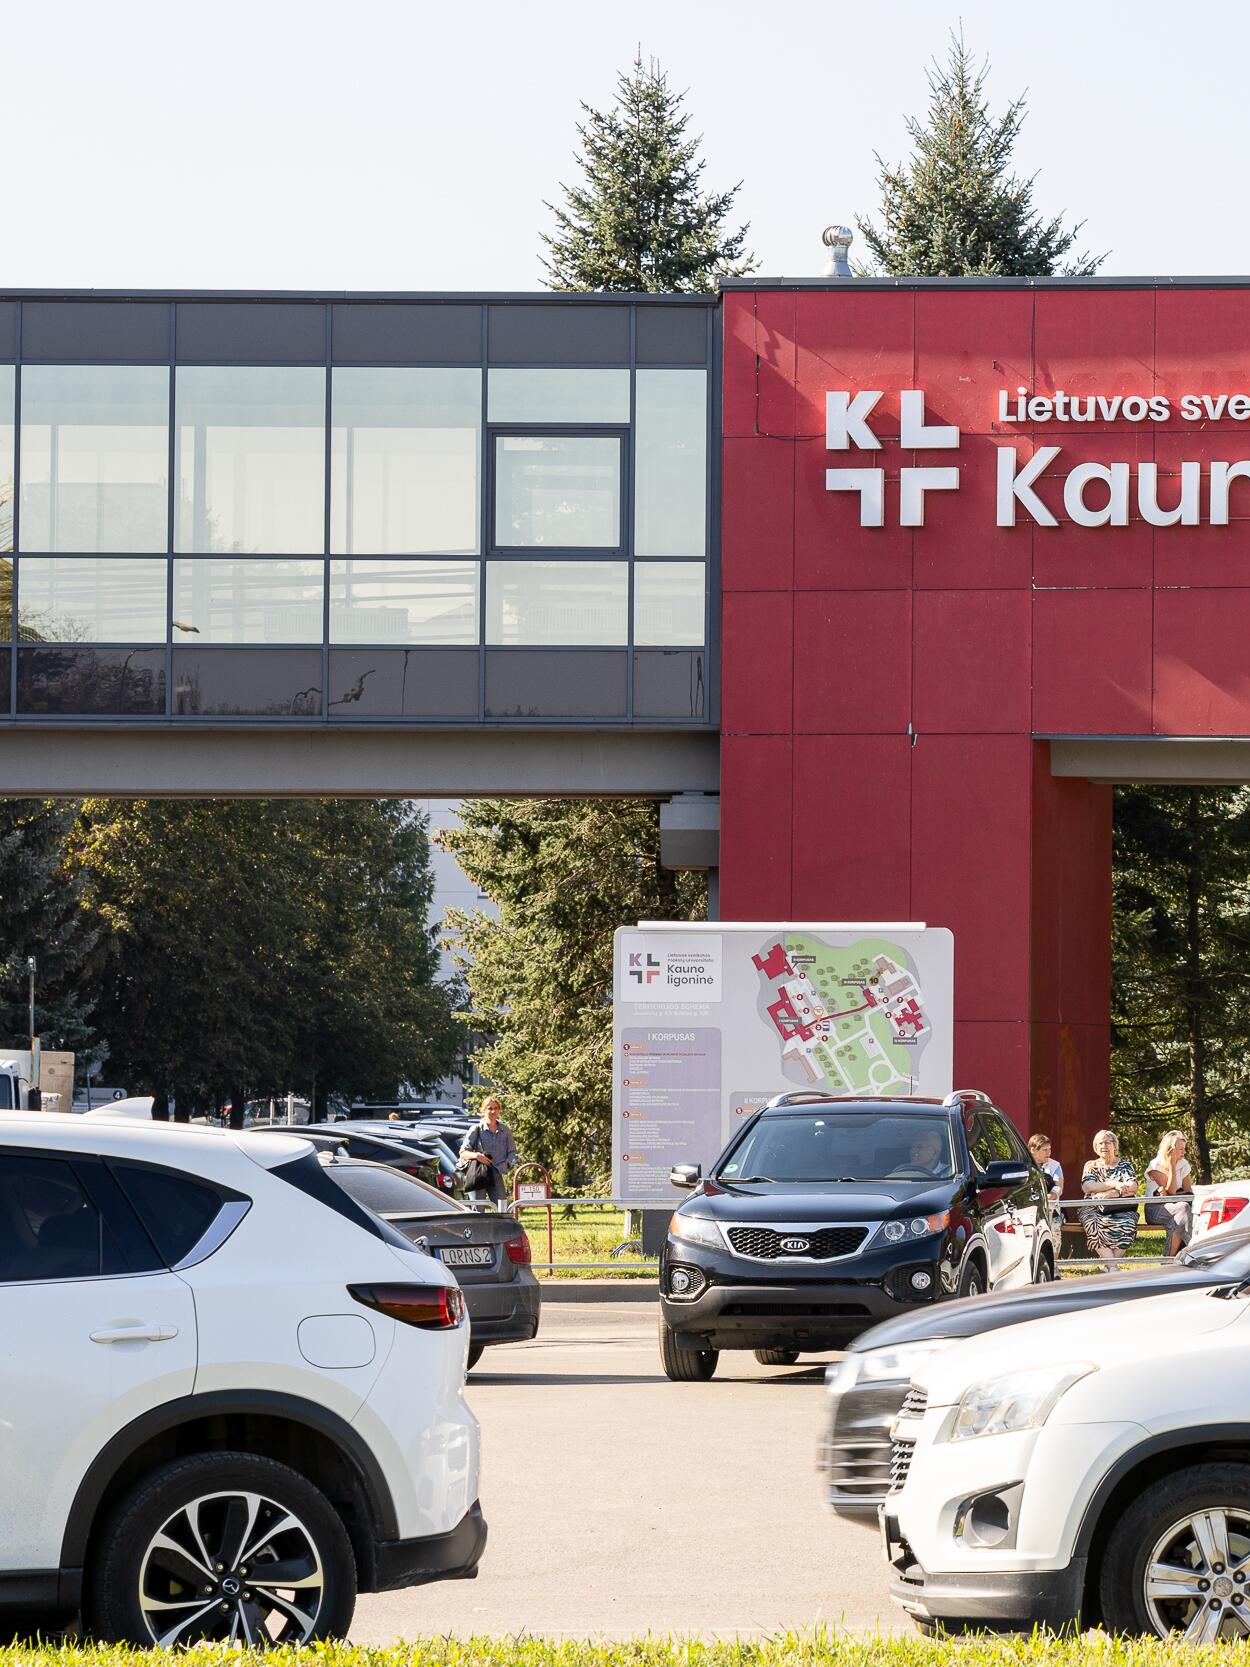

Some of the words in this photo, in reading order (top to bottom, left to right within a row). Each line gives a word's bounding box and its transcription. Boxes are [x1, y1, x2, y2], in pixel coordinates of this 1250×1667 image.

[998, 386, 1171, 423] Lietuvos
[667, 964, 705, 974] Kauno
[667, 975, 714, 987] ligoninė
[652, 1032, 696, 1041] KORPUSAS
[787, 1241, 804, 1249] KIA
